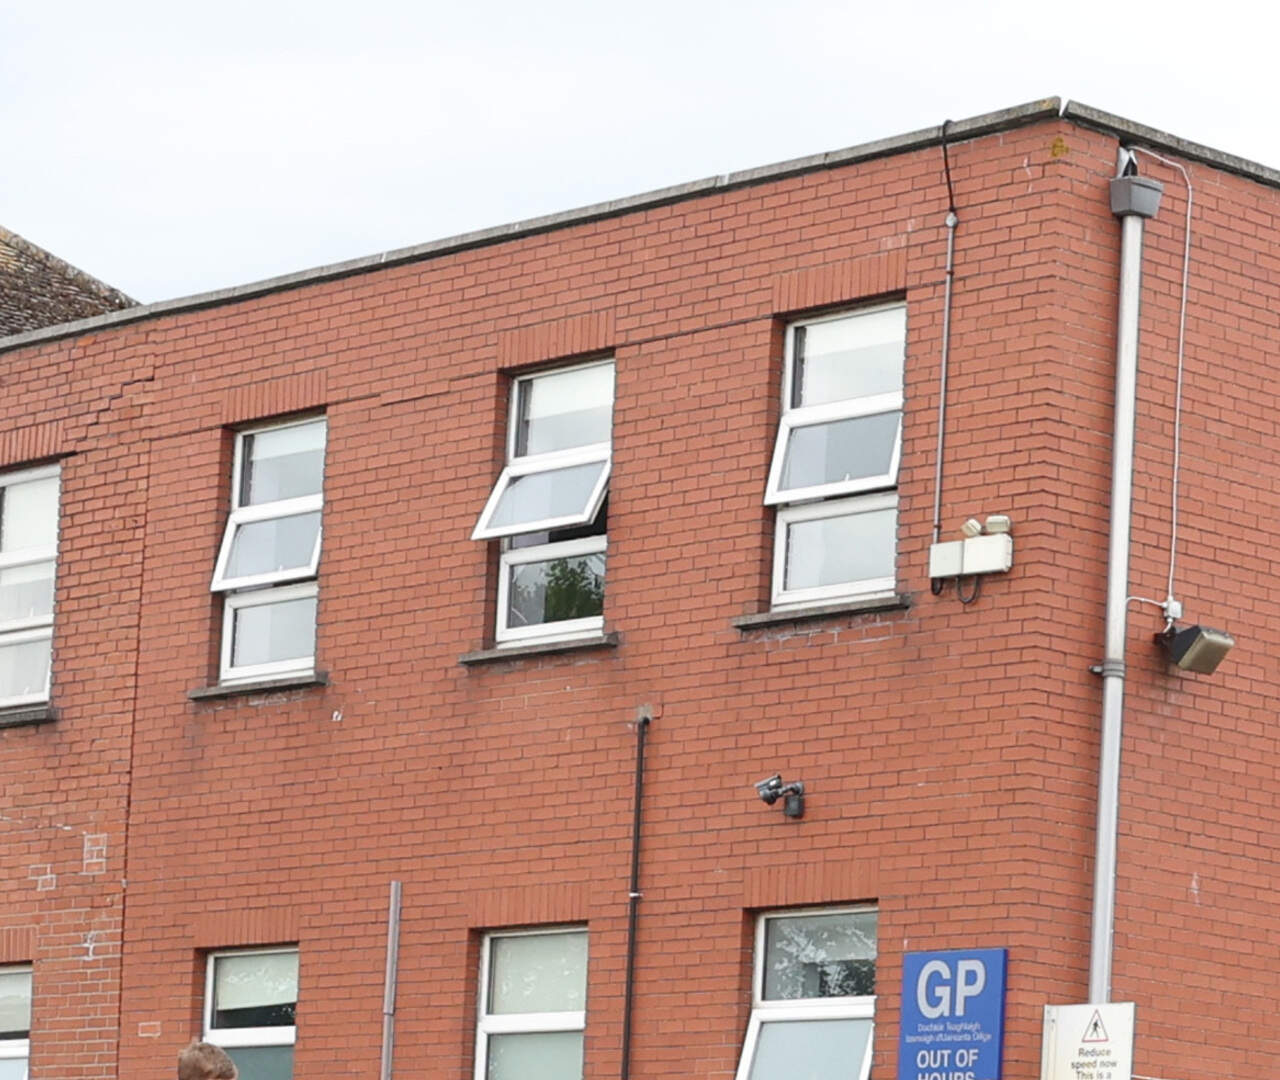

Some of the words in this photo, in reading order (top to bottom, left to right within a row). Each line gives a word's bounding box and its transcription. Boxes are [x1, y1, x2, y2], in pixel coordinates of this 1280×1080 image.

[917, 959, 986, 1019] GP
[1078, 1047, 1111, 1057] Reduce
[916, 1050, 952, 1069] OUT
[955, 1048, 979, 1067] OF
[1071, 1060, 1097, 1069] speed
[1076, 1070, 1093, 1080] This
[1097, 1071, 1104, 1079] is
